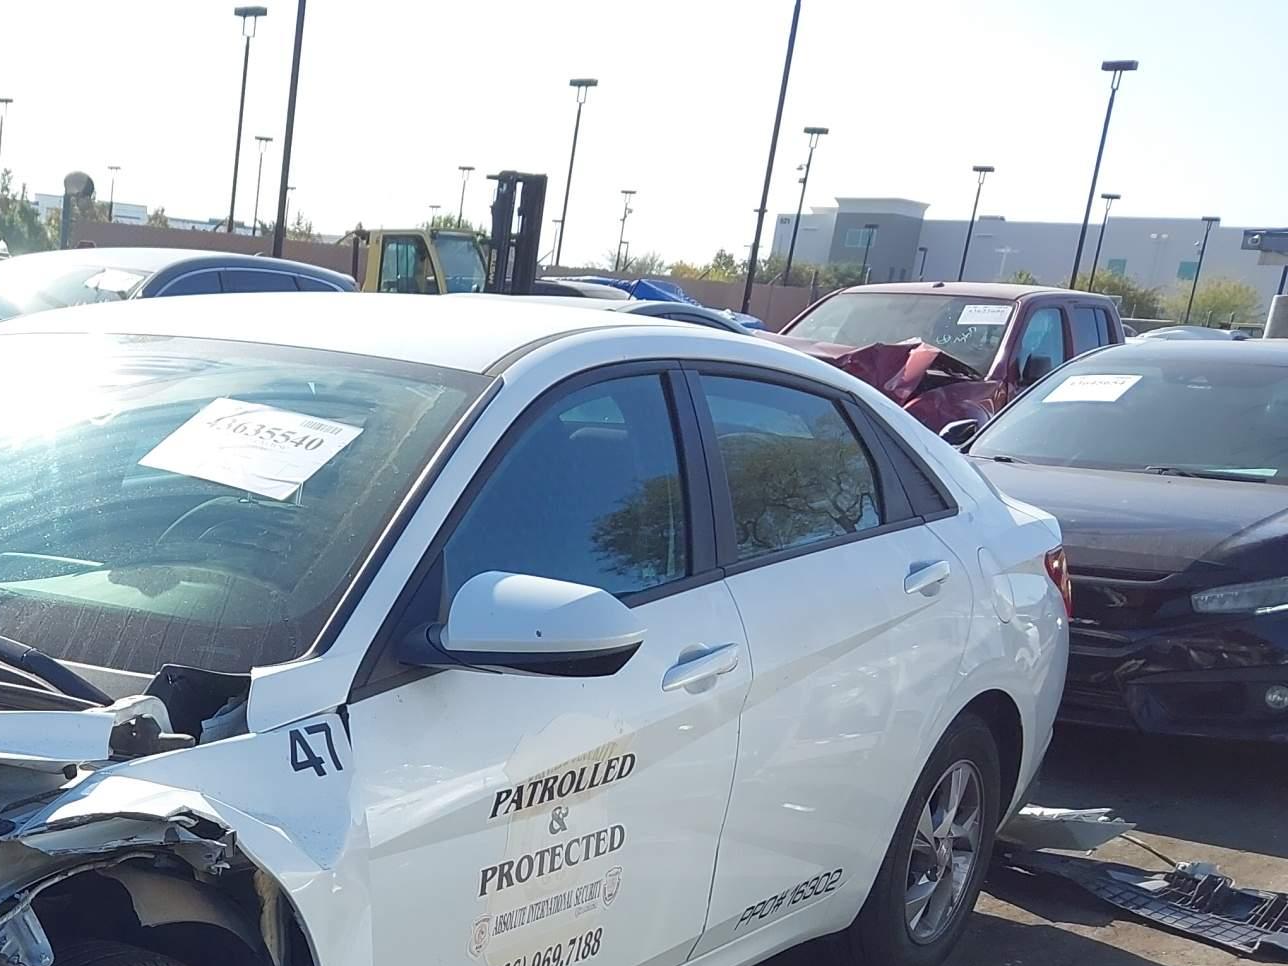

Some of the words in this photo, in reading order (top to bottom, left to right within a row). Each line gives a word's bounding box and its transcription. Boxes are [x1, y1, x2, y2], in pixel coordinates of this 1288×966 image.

[289, 722, 344, 776] 47
[488, 753, 637, 819] PATROLLED
[548, 805, 570, 835] &
[478, 824, 626, 897] PROTECTED
[787, 868, 843, 908] 16302
[492, 906, 528, 937] ABSOLUTE
[526, 889, 574, 924] INTERNATIONAL
[574, 879, 603, 907] SECURITY
